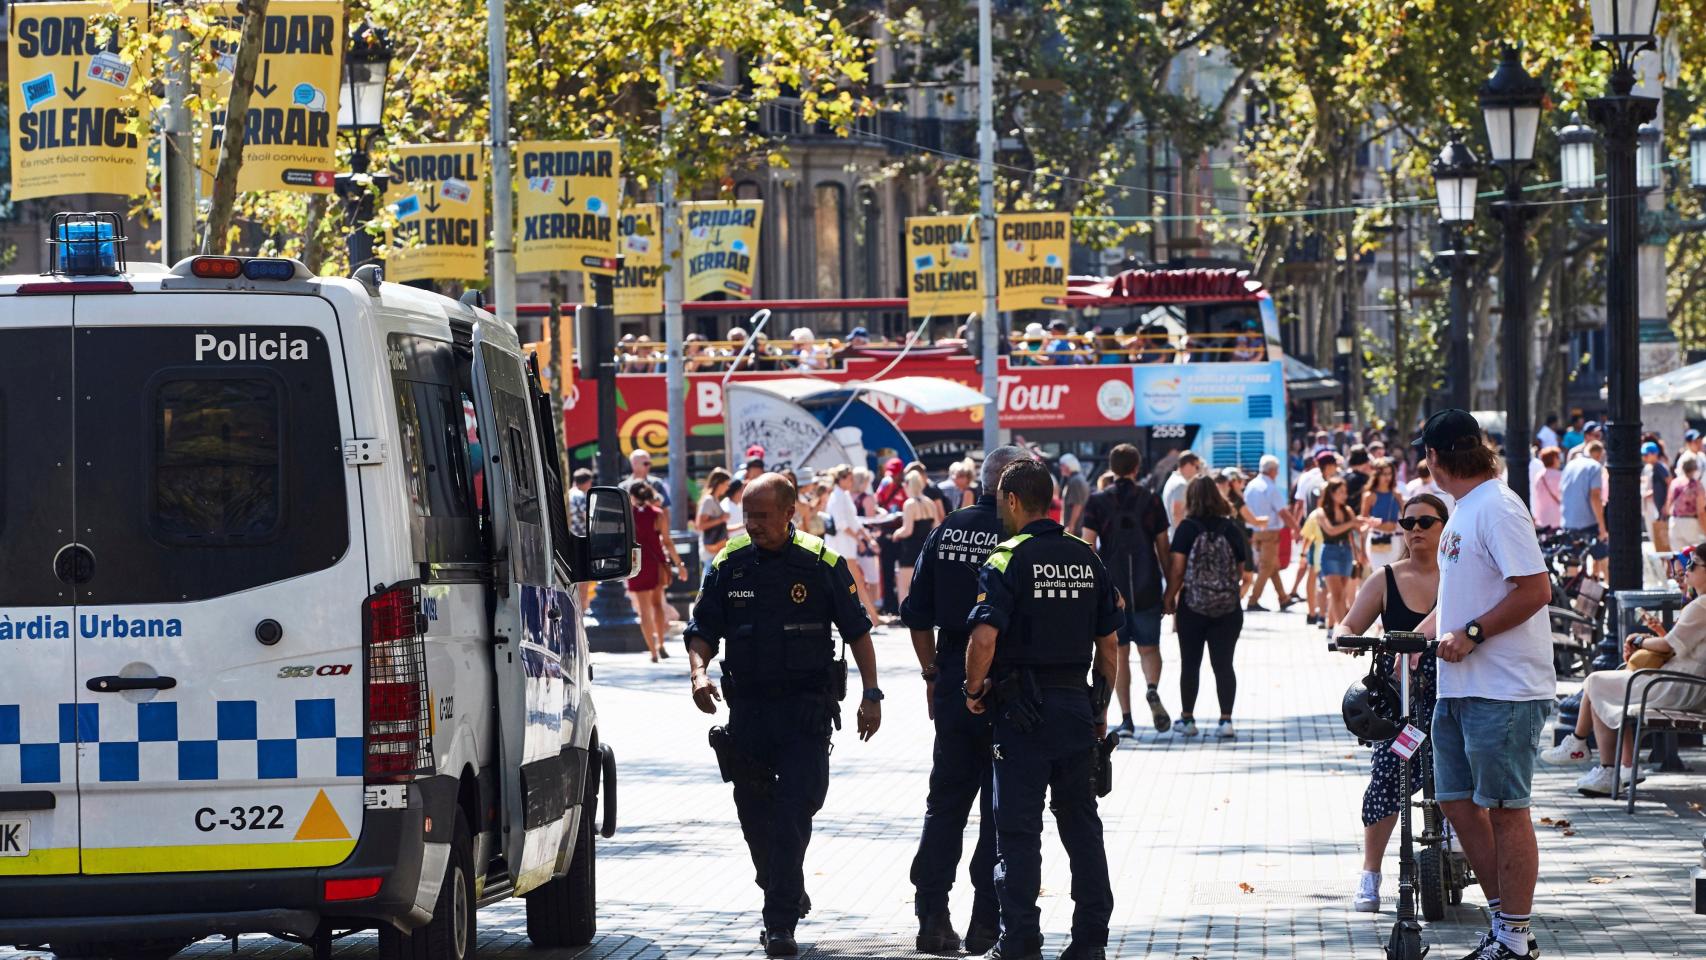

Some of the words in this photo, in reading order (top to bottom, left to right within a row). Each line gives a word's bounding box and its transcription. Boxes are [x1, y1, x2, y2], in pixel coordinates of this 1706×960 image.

[18, 16, 137, 58] SORL
[211, 16, 334, 55] DAR
[210, 108, 330, 149] XRRAR
[57, 154, 79, 164] fàcil
[81, 154, 136, 165] conviure.
[273, 153, 329, 163] conviure.
[389, 154, 478, 184] SOROLL
[524, 151, 612, 178] CRIDAR
[524, 213, 611, 242] XERRAR
[688, 209, 756, 229] CRIDAR
[912, 224, 975, 246] SOROLL
[1003, 221, 1065, 241] CRIDAR
[689, 251, 750, 277] XERRAR
[914, 270, 978, 292] SILENCI
[1004, 266, 1064, 288] XERRAR
[195, 332, 308, 361] Policia
[997, 375, 1070, 411] Tour
[1152, 424, 1186, 438] 2555
[941, 528, 998, 546] POLICIA
[939, 543, 968, 552] guàrdia
[969, 545, 992, 554] urban
[1032, 564, 1094, 579] POLICIA
[1034, 580, 1066, 589] guàrdia
[80, 614, 181, 638] Urbana
[316, 664, 352, 676] CDI
[195, 805, 284, 832] C-322
